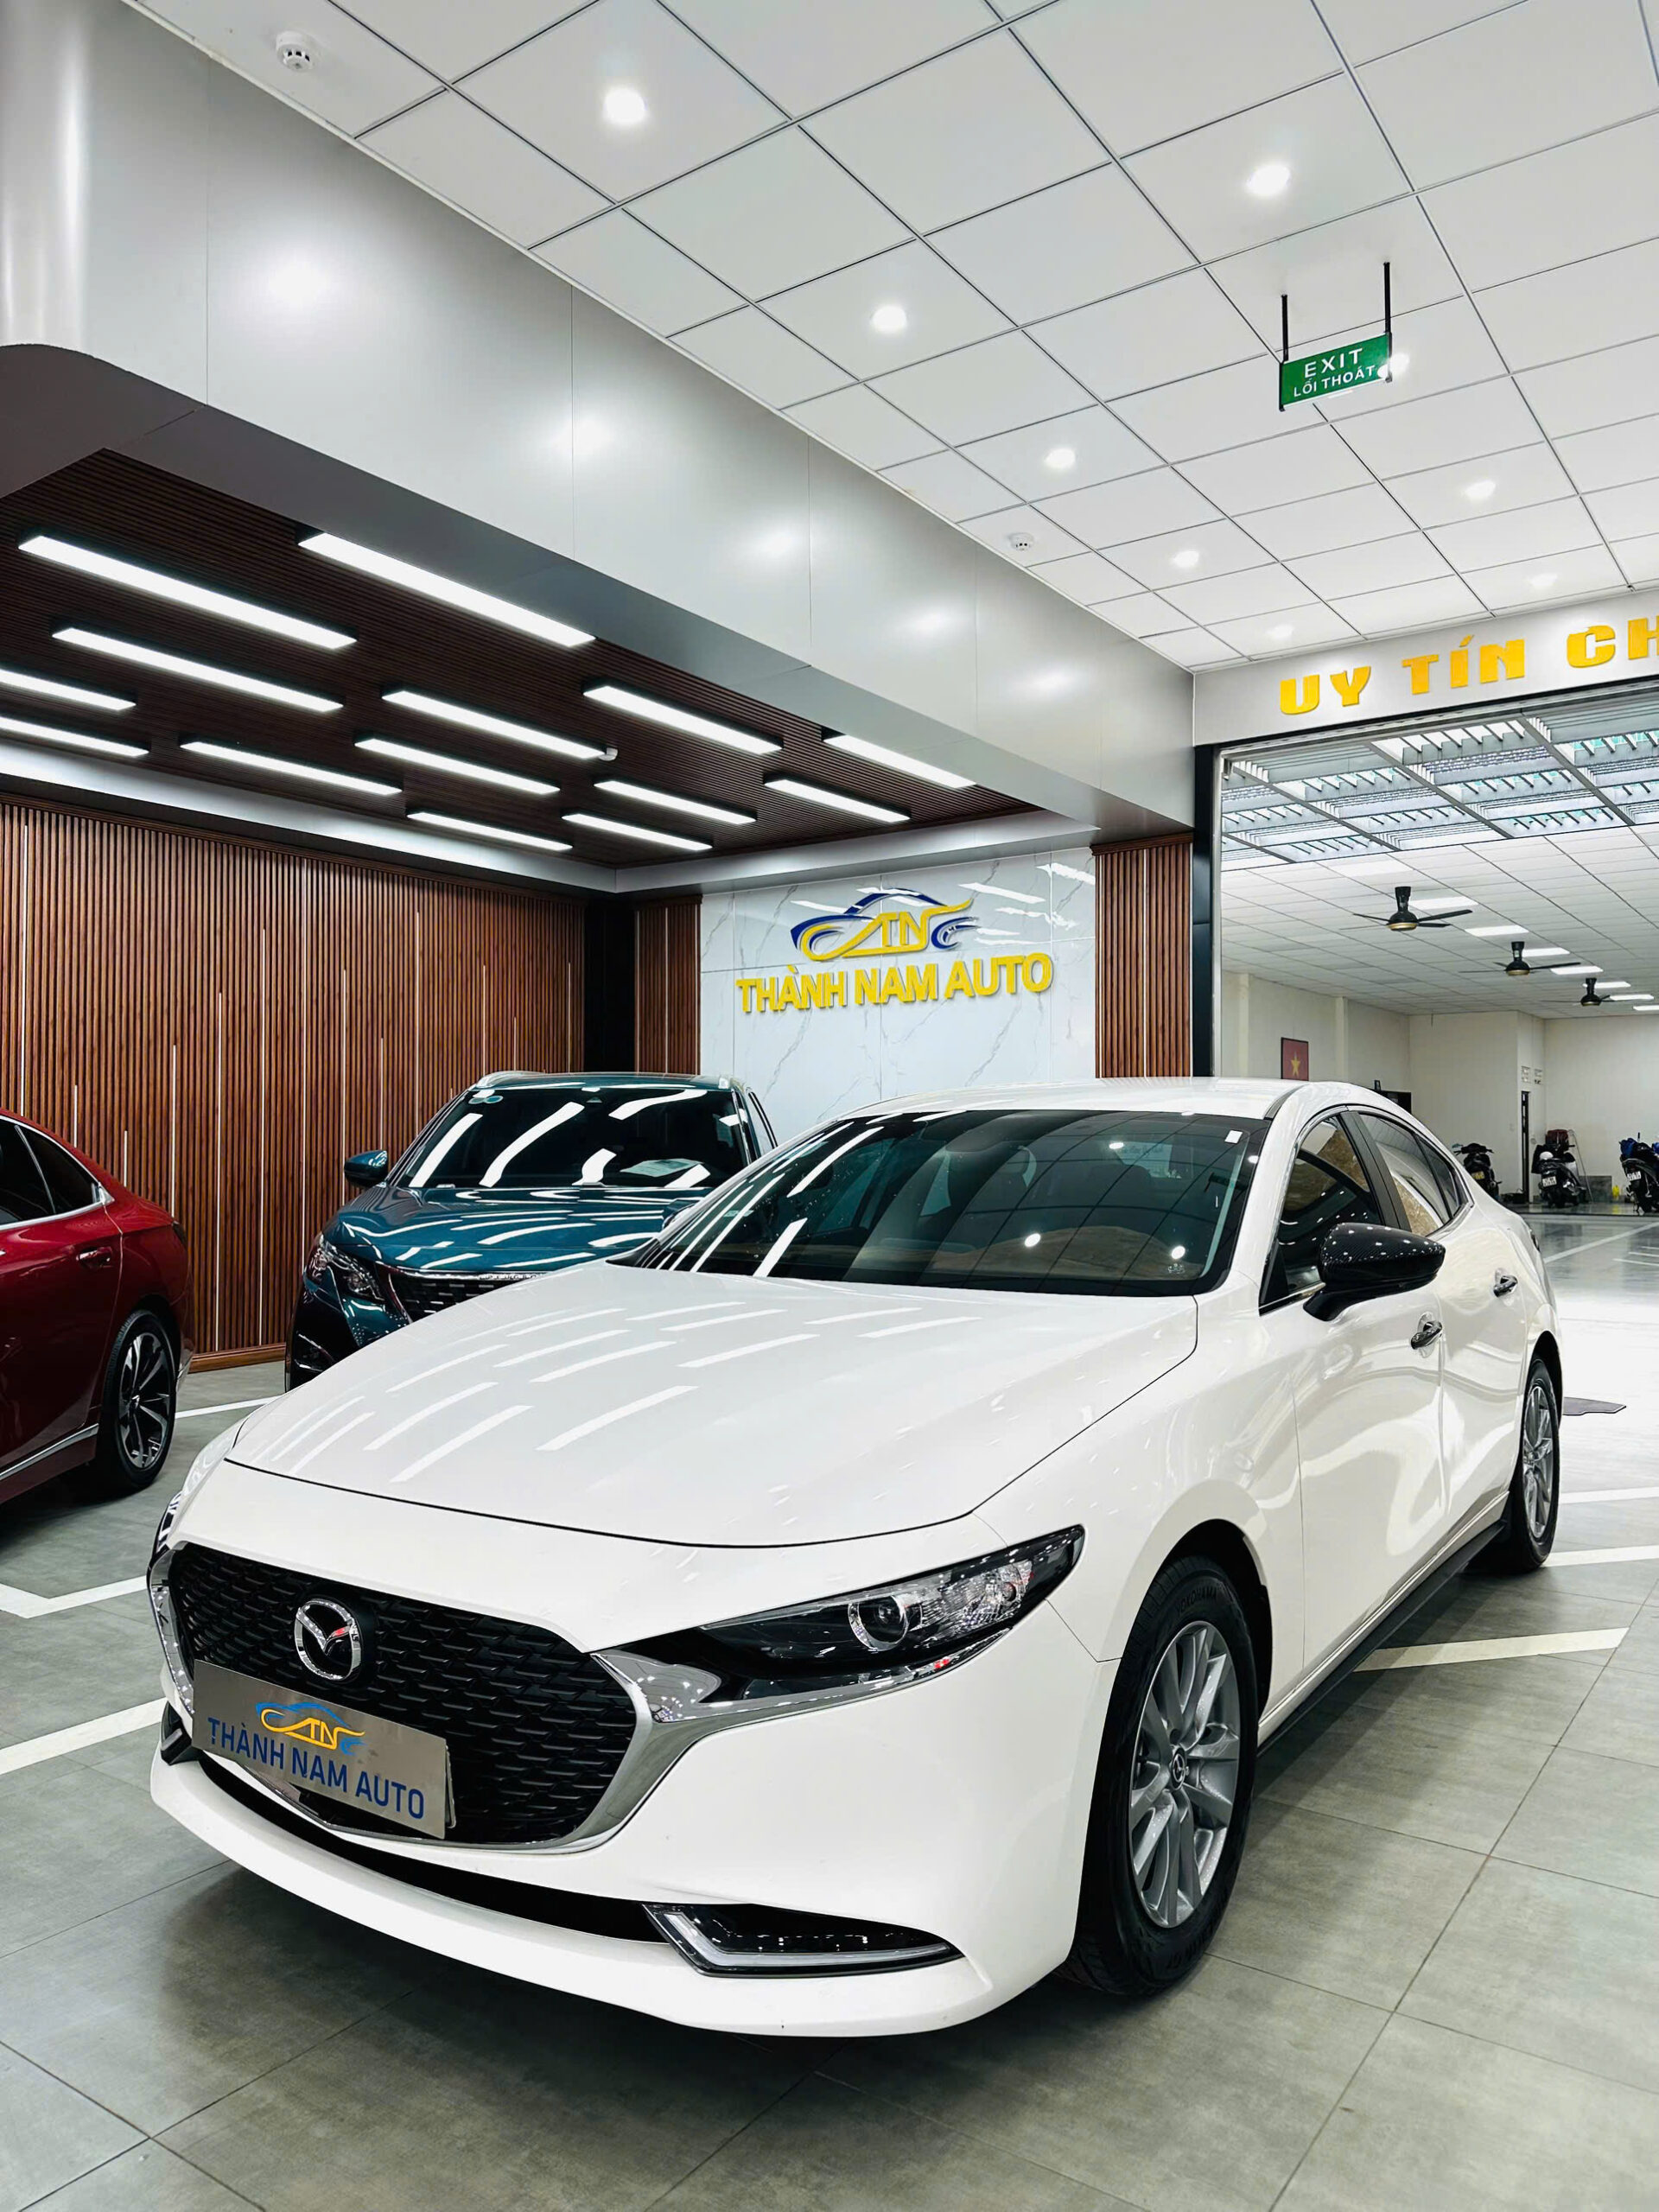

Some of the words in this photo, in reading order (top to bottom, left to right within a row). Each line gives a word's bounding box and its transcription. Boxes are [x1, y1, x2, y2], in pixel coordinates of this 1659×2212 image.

[1294, 378, 1317, 397] LỐI
[1321, 365, 1376, 389] THOÁT
[1304, 347, 1363, 378] EXIT
[1280, 665, 1371, 715] UY
[1402, 634, 1526, 696] TÍN
[1567, 615, 1659, 669] CH
[735, 964, 848, 1014] THÀNH
[854, 963, 938, 1006] NAM
[944, 952, 1054, 1000] AUTO
[207, 1716, 285, 1770] THÀNH
[291, 1747, 348, 1792] NAM
[355, 1770, 425, 1820] AUTO
